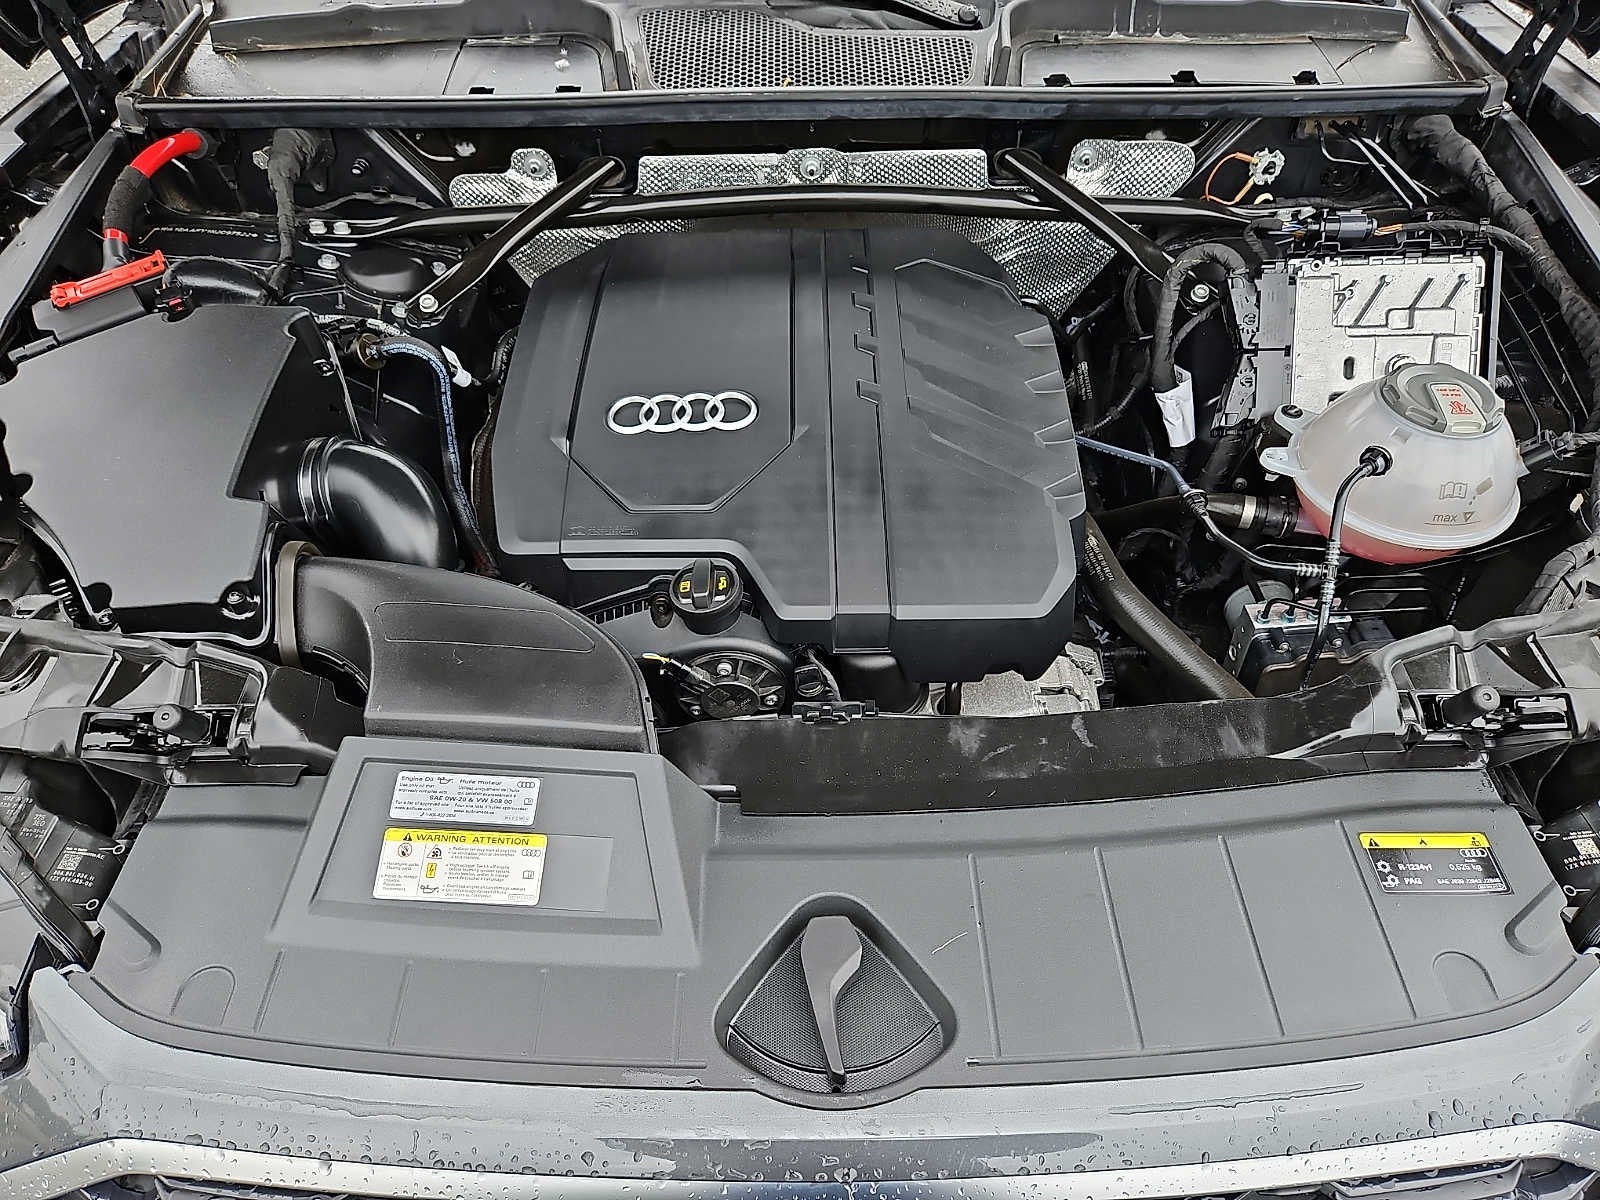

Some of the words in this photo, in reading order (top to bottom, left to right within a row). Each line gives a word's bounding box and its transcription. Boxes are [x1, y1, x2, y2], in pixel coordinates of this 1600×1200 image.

[1432, 514, 1458, 522] max
[401, 775, 423, 783] Engine
[416, 833, 467, 843] WARNING
[472, 836, 530, 845] ATTENTION
[1471, 863, 1483, 872] kg
